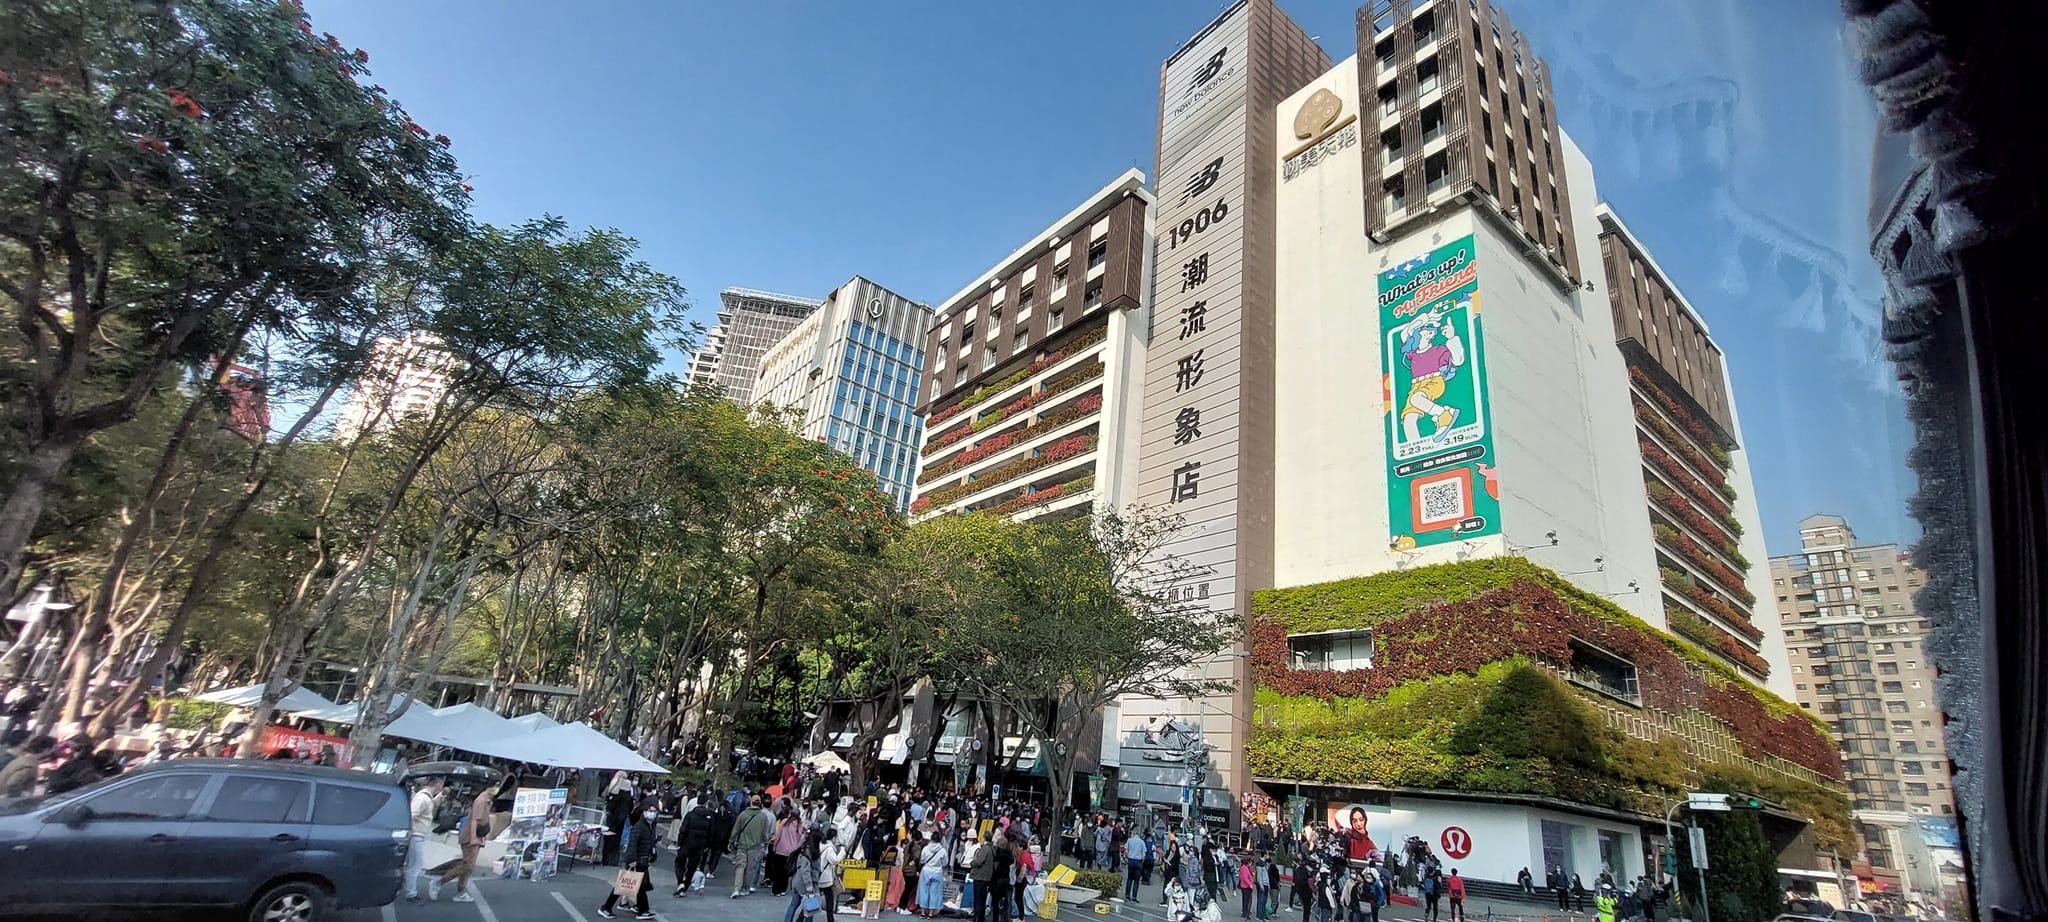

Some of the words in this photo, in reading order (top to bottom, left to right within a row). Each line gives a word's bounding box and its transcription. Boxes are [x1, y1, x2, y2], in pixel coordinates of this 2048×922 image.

[1173, 98, 1194, 117] new
[1193, 67, 1235, 102] balance
[1168, 197, 1229, 250] 1906
[1378, 268, 1435, 306] What's
[1438, 249, 1466, 274] up!
[1393, 298, 1419, 318] My
[1414, 260, 1477, 303] Friend
[1169, 252, 1209, 505] 潮流形象店
[1399, 445, 1421, 457] 2.23
[1443, 434, 1465, 446] 3.19
[1203, 813, 1226, 823] balance
